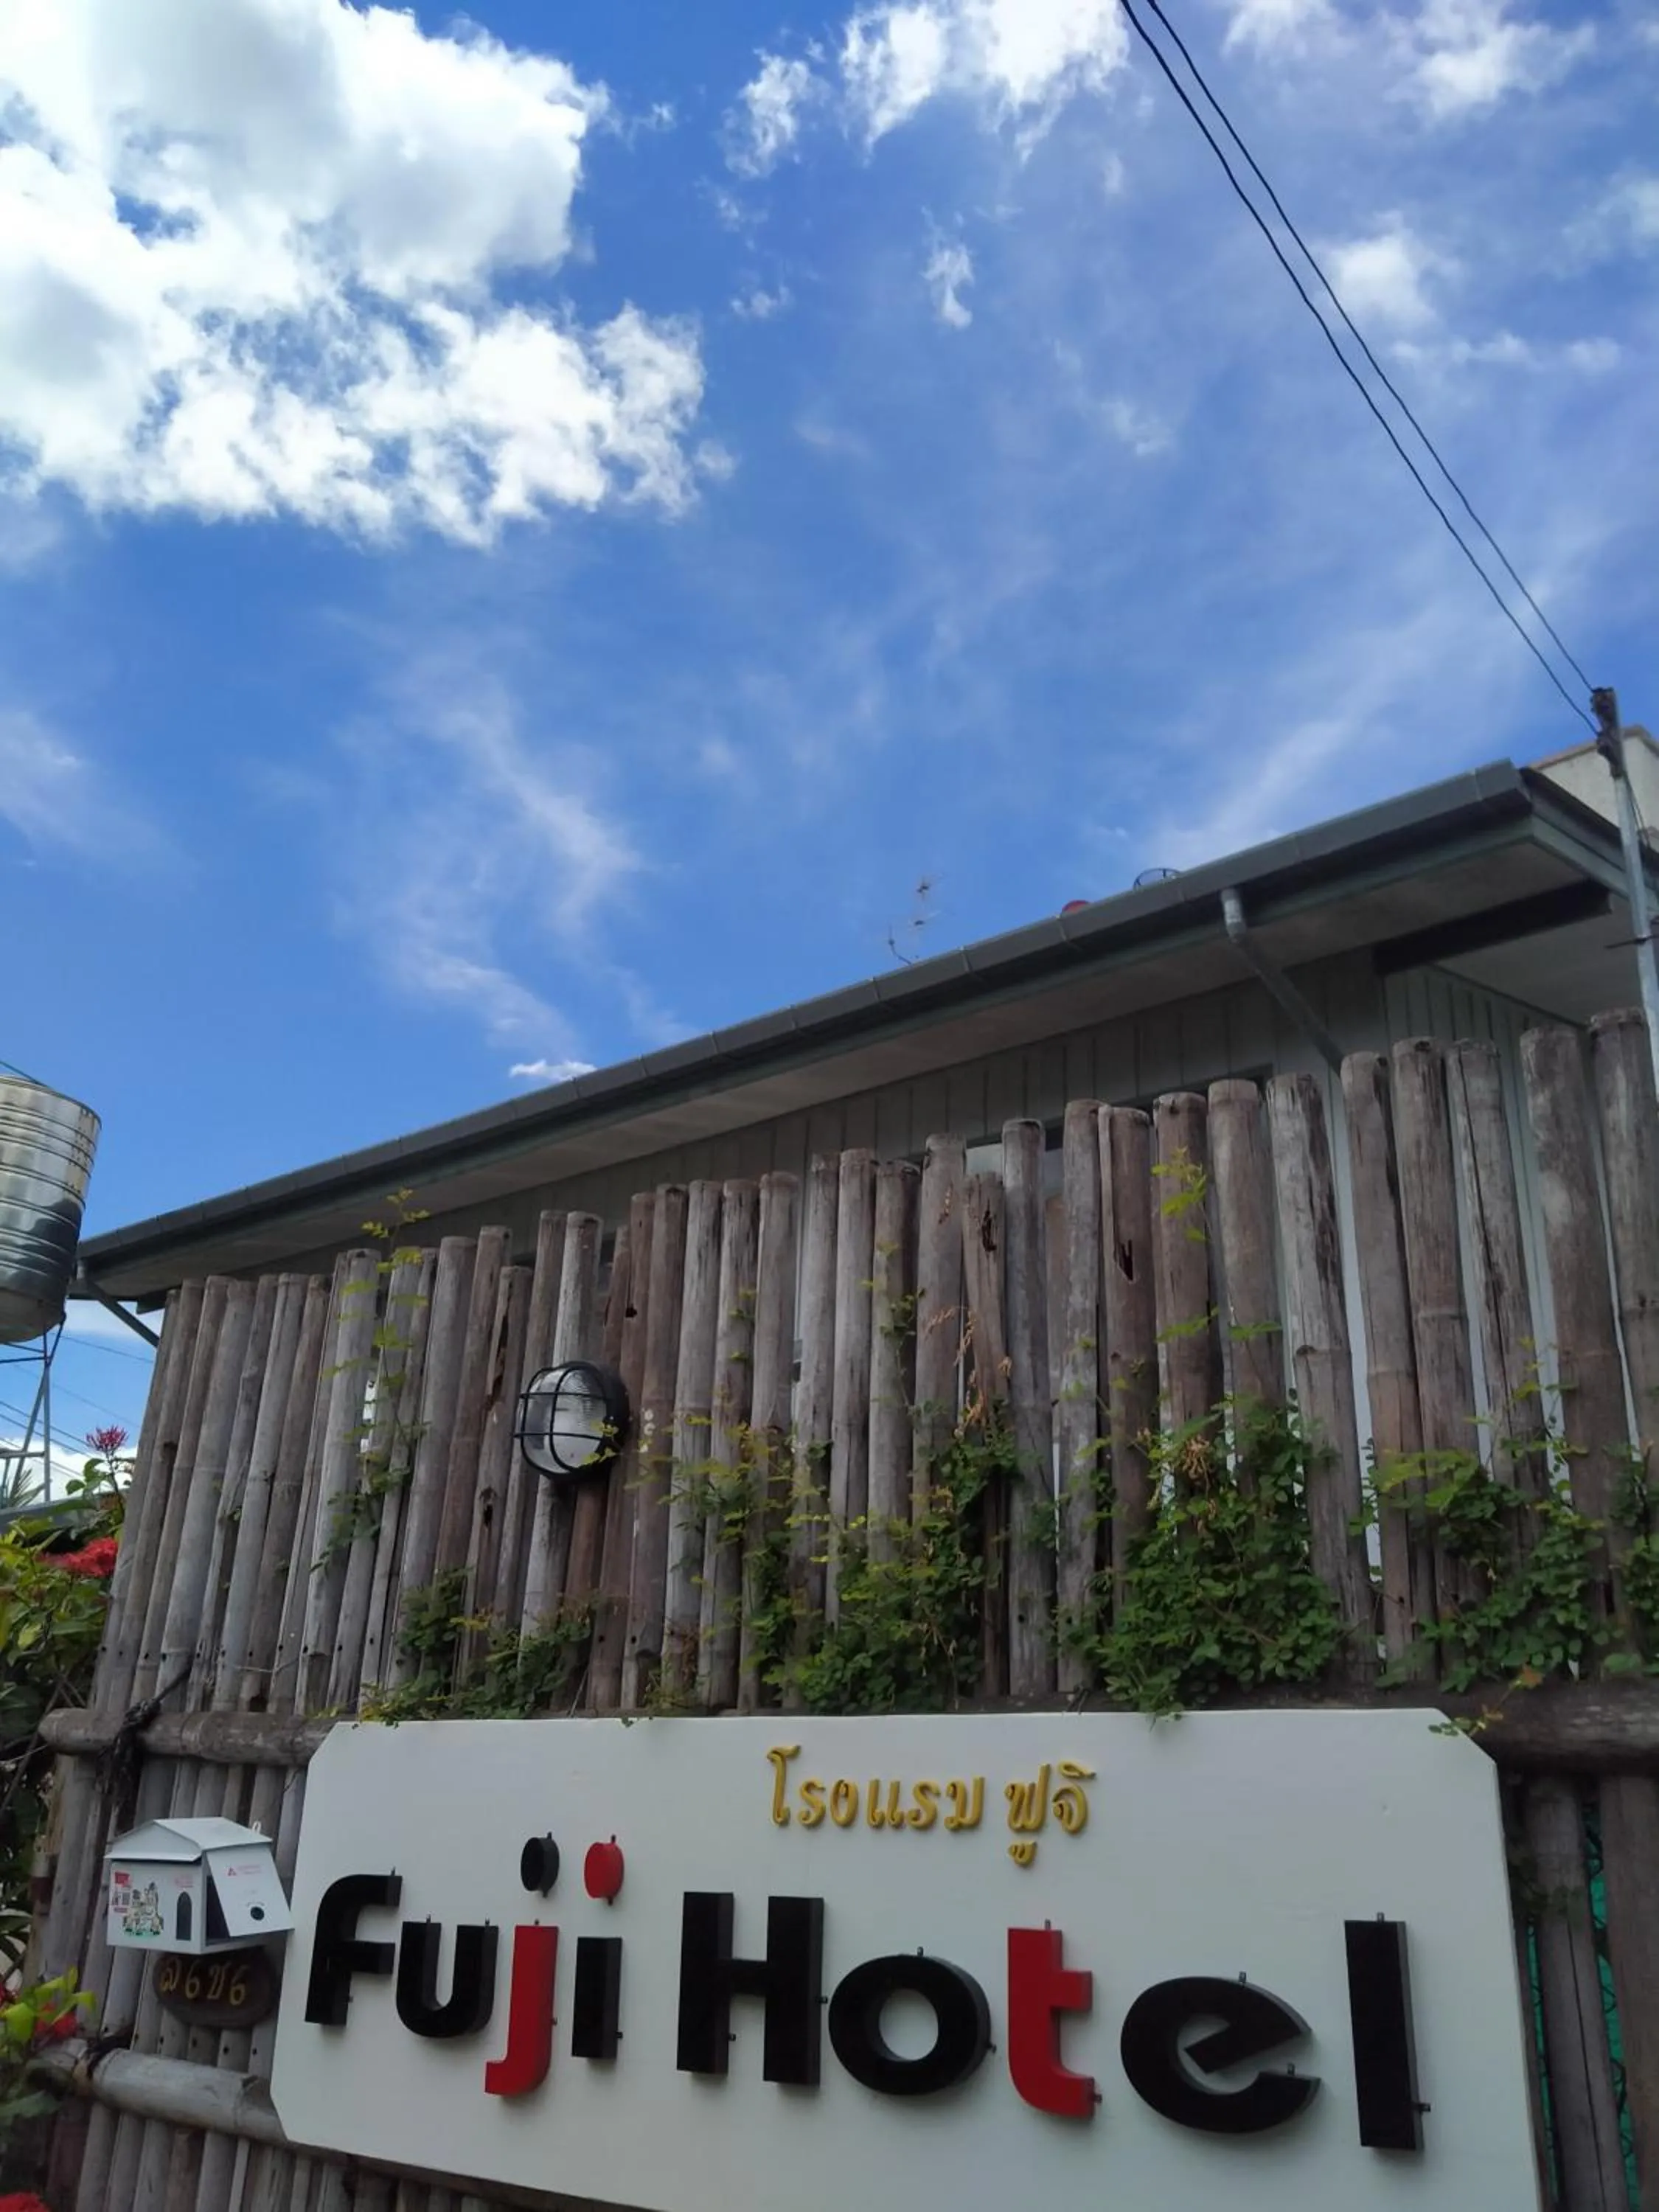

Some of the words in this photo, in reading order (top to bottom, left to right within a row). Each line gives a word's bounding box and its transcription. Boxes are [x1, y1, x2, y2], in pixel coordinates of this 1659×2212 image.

[766, 1745, 985, 1829] โรงแรม
[1004, 1761, 1096, 1868] ฟูจิ
[304, 1833, 625, 2096] Fuji
[676, 1891, 1426, 2152] Hotel
